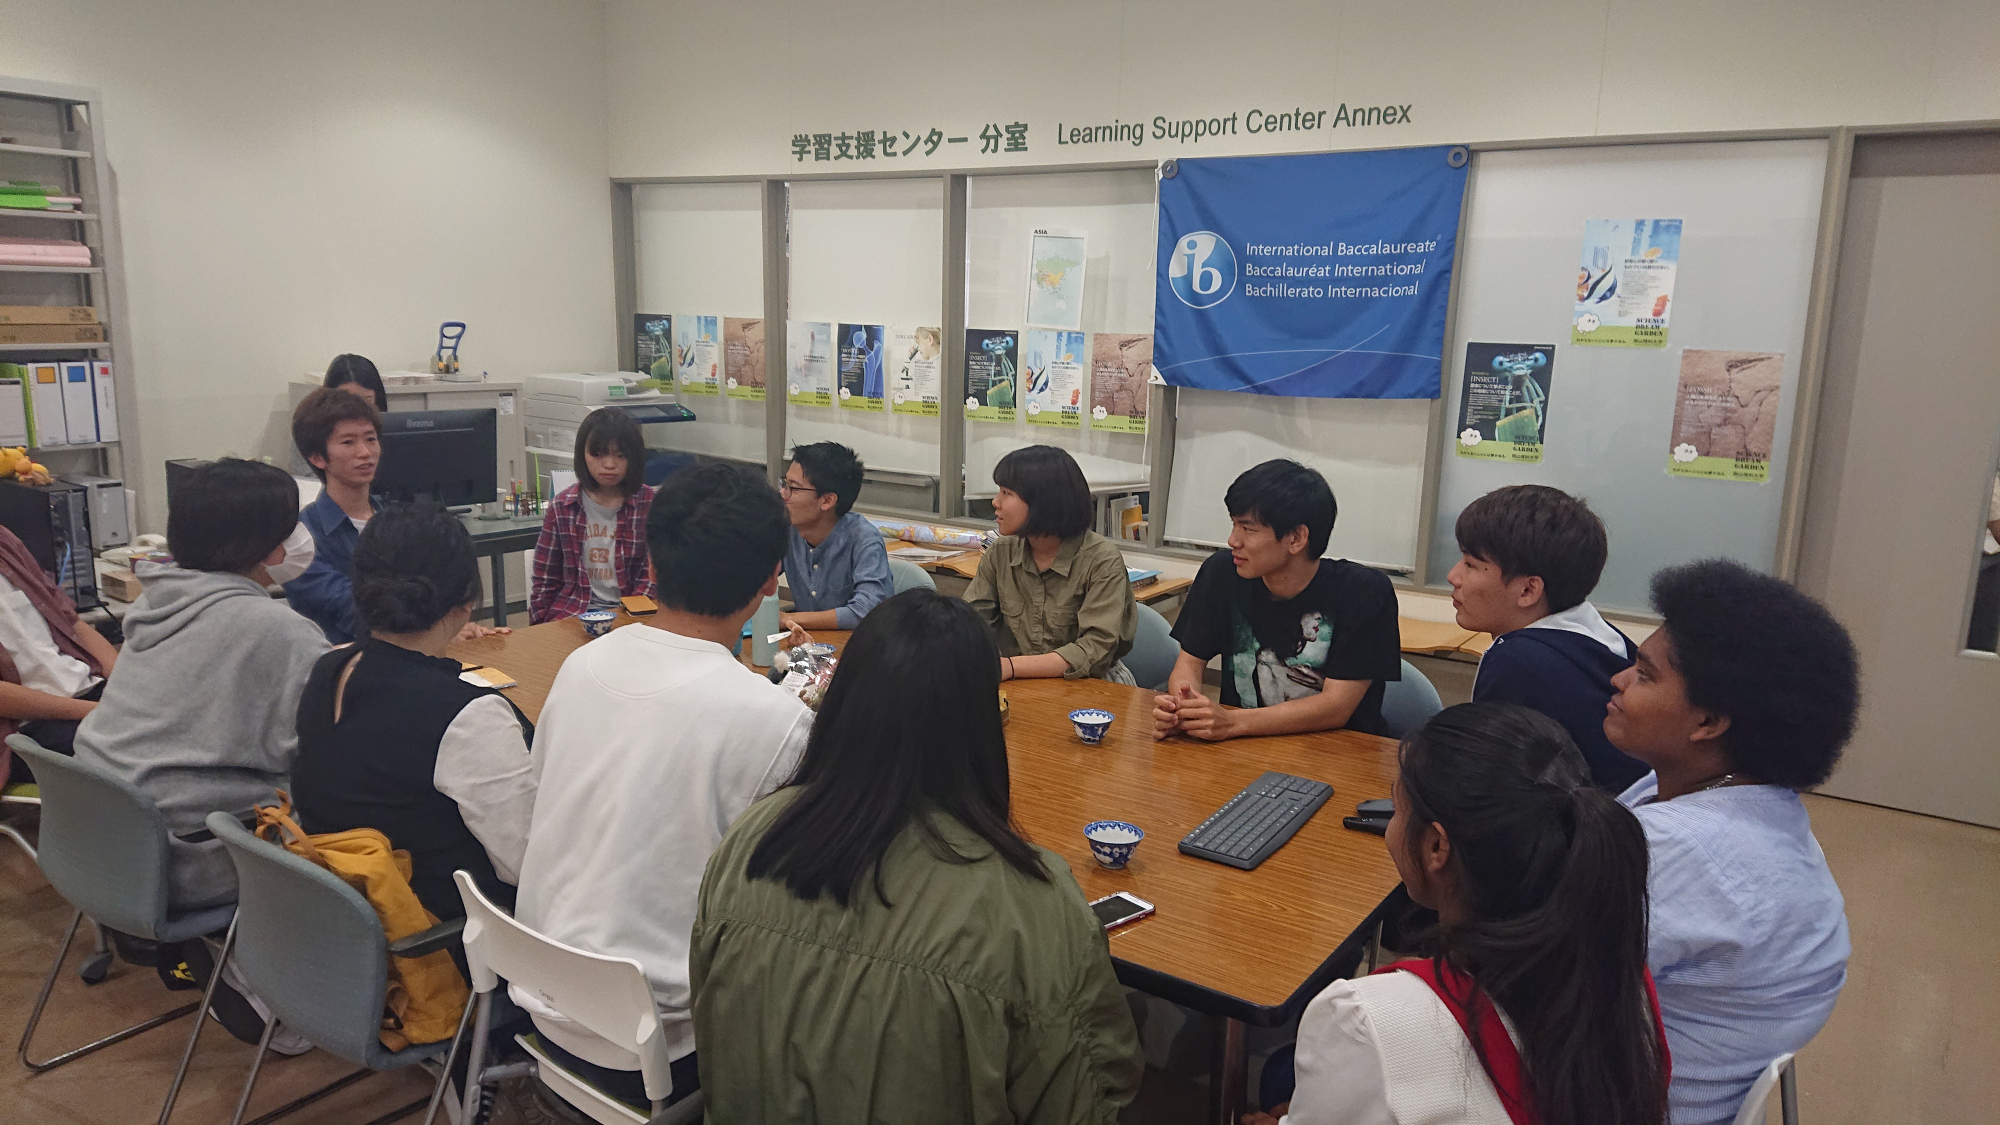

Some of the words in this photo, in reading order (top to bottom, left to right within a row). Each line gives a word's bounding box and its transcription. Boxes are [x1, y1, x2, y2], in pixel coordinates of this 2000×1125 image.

[1058, 119, 1144, 147] Learning
[1152, 112, 1238, 144] Support
[1246, 107, 1326, 134] Center
[1333, 103, 1412, 128] Annex
[791, 127, 969, 162] 学習支援センター
[979, 121, 1029, 154] 分室
[1246, 242, 1333, 257] International
[1338, 240, 1437, 256] Baccalaureate
[1246, 263, 1331, 278] Baccalauréat
[1335, 259, 1426, 277] International
[1246, 283, 1324, 298] Bachillerato
[1328, 281, 1419, 297] Internacional
[592, 549, 606, 561] 32
